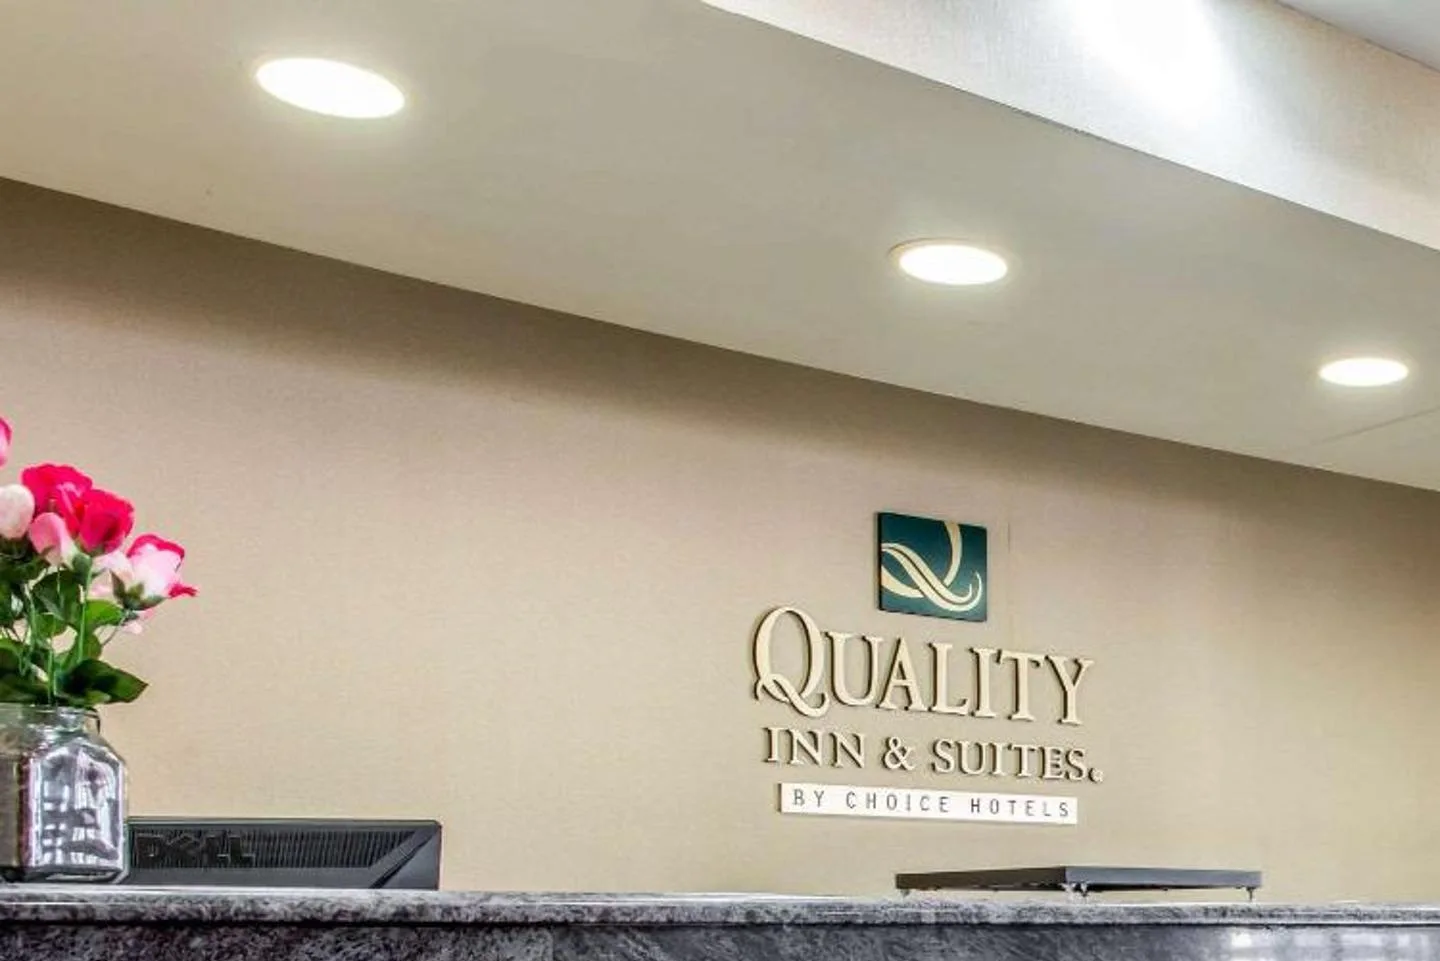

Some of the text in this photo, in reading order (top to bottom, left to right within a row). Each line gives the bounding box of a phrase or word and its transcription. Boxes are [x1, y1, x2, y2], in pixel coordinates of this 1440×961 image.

[753, 605, 1094, 726] QUALITY
[762, 727, 1088, 782] INN & SUITES
[792, 788, 1069, 818] BY CHOICE HOTELS
